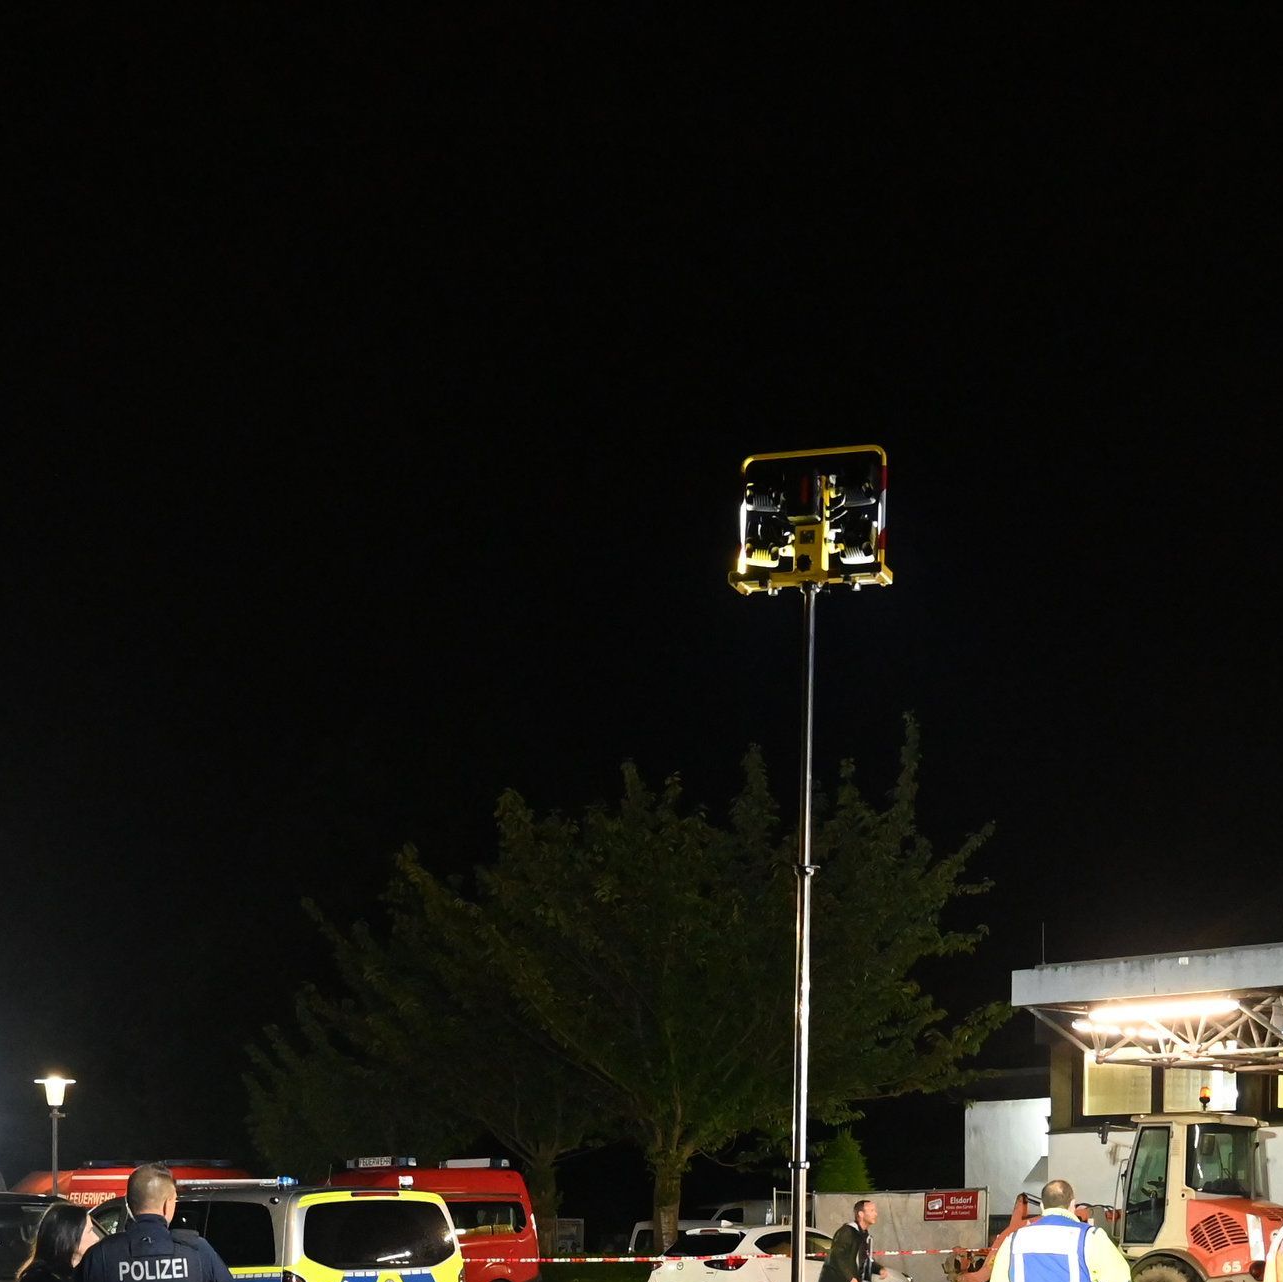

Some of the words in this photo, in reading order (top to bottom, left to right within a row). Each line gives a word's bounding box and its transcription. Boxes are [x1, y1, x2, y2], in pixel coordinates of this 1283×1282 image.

[950, 1196, 972, 1204] Elsdorf
[119, 1257, 189, 1282] POLIZEI
[1221, 1261, 1242, 1274] 65
